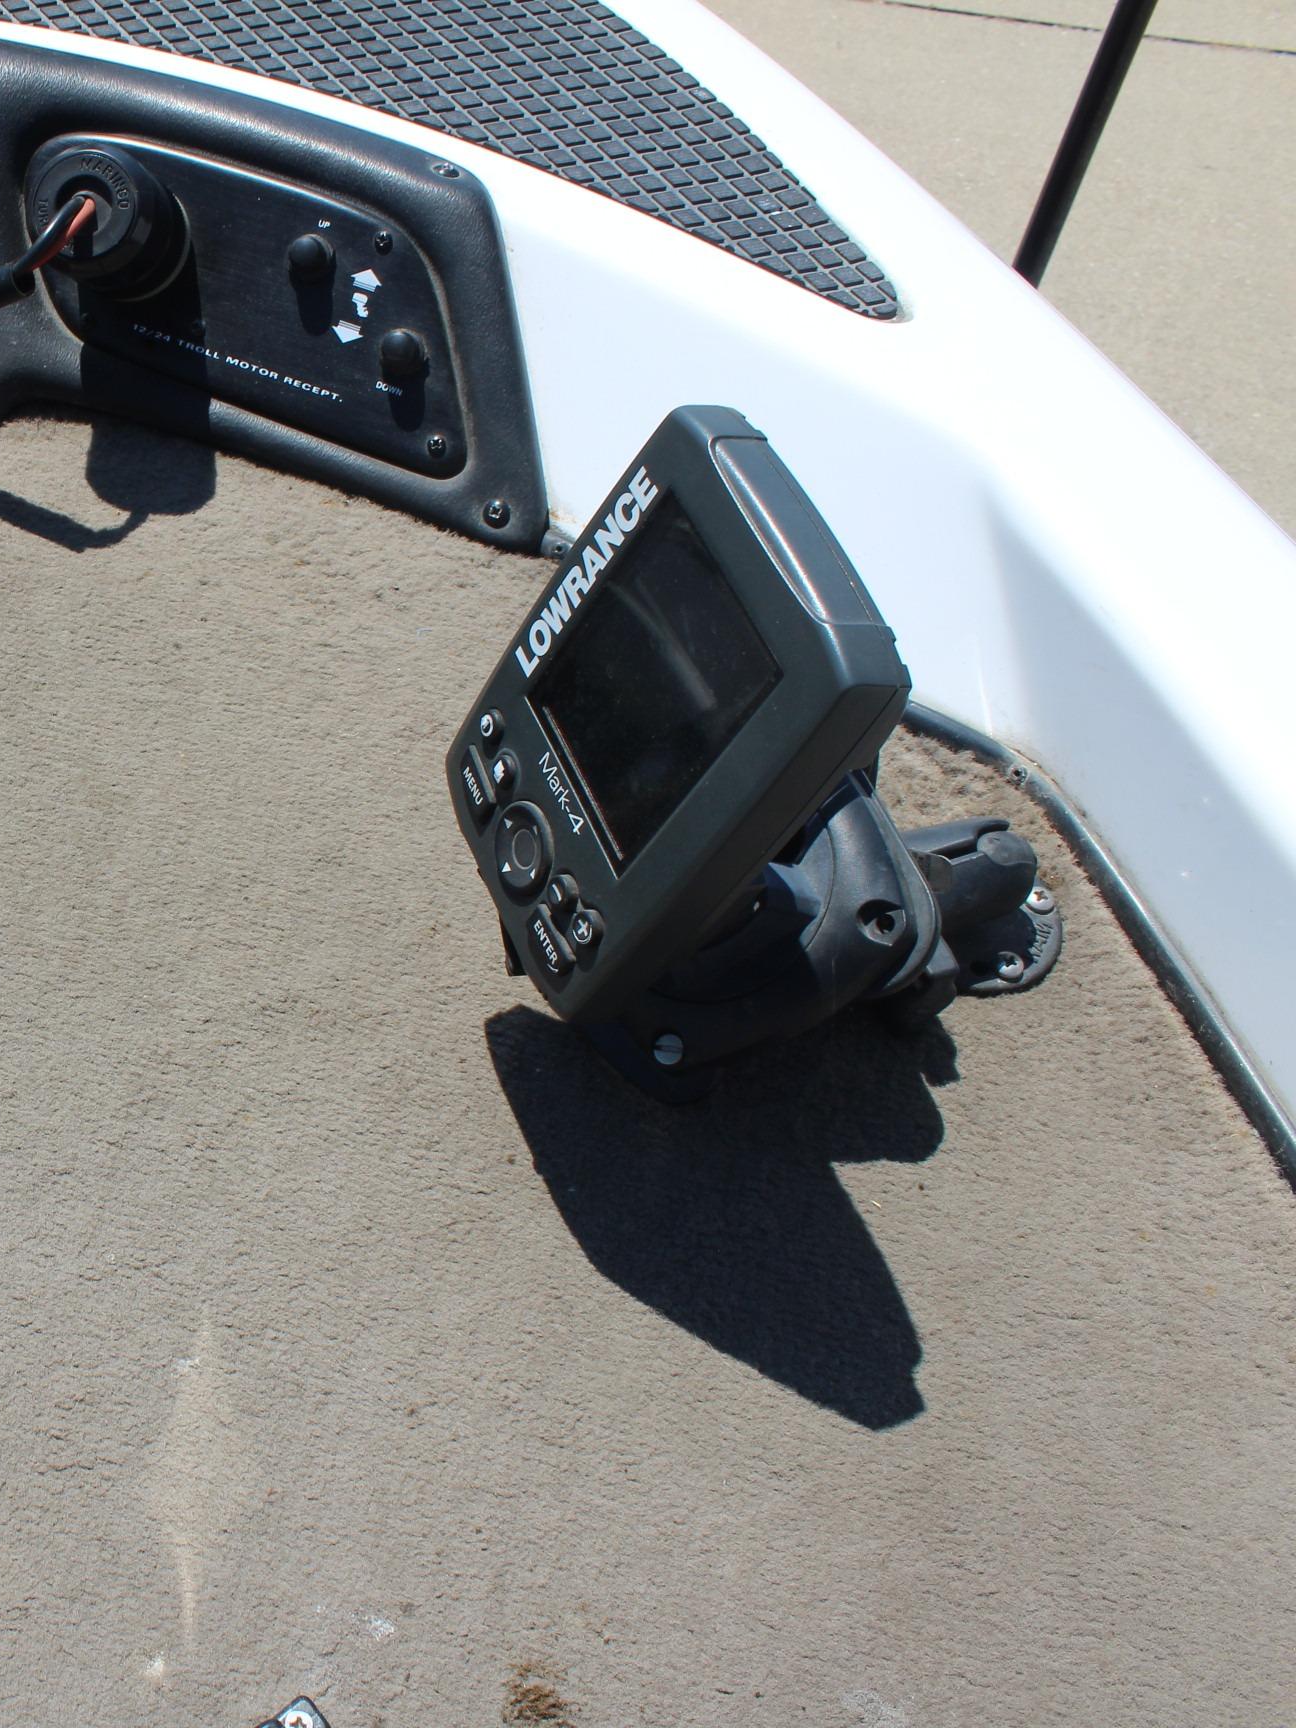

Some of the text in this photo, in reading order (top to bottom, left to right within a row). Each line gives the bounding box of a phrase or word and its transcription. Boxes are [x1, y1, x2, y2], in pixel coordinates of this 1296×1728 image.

[317, 218, 331, 229] UP
[132, 323, 344, 402] 12/24 TROLL MOTOR RECEPT.
[375, 380, 403, 397] DOWN
[514, 465, 659, 679] LOWRANCE
[462, 766, 484, 806] MENU
[538, 751, 585, 836] Mark-4
[533, 919, 558, 966] ENTER
